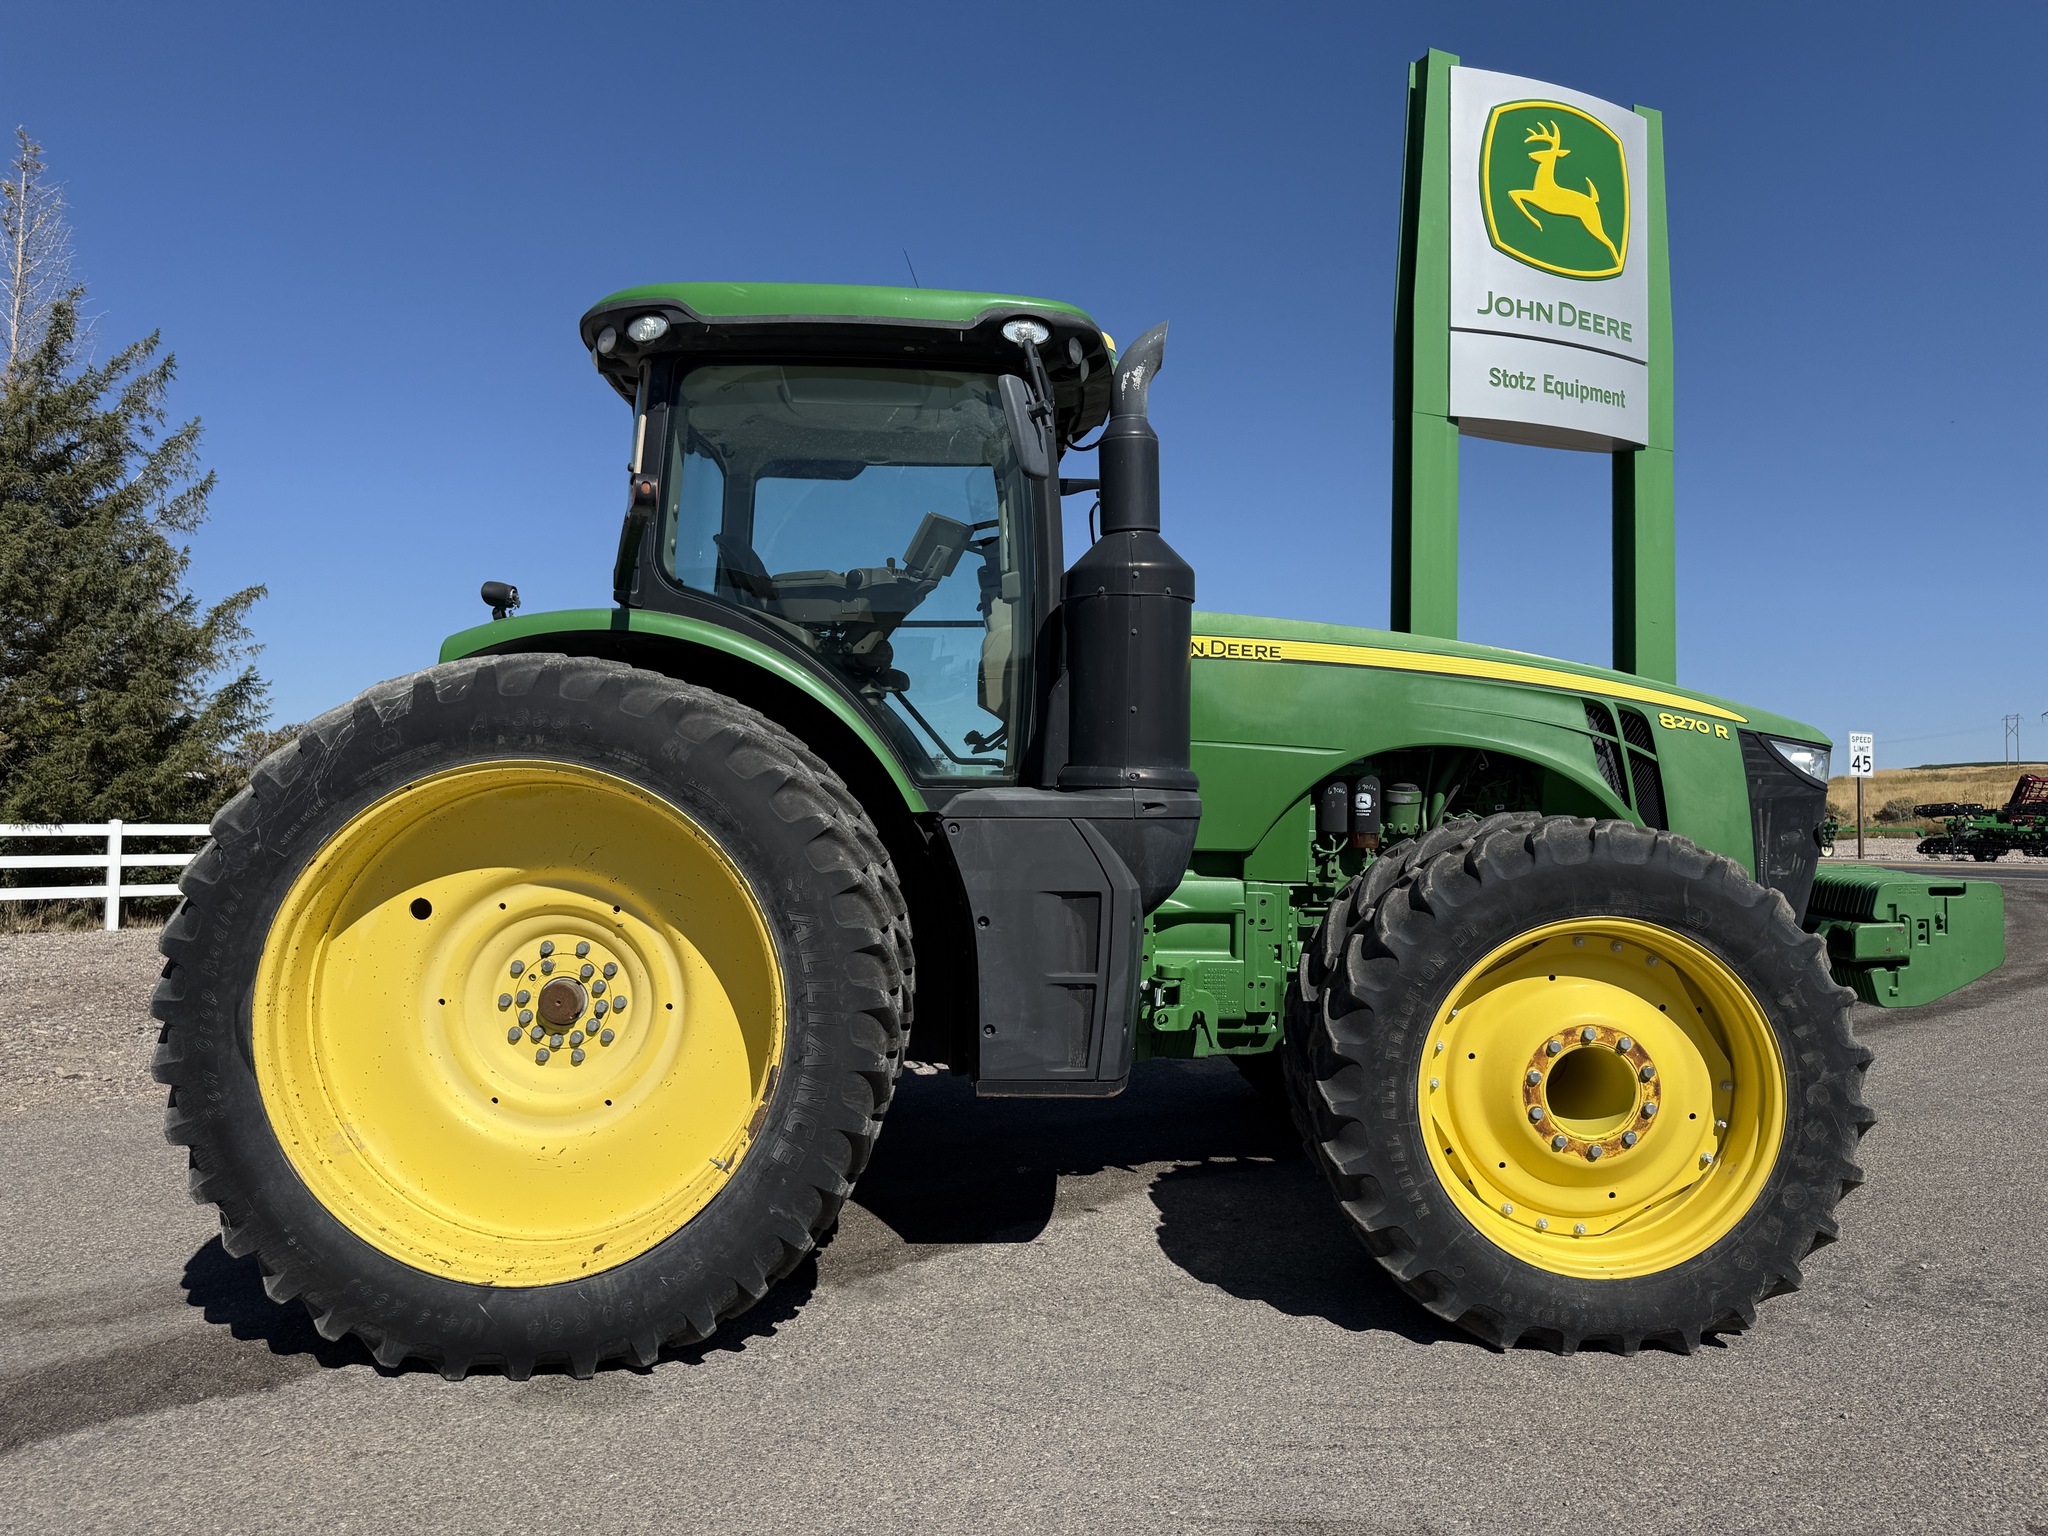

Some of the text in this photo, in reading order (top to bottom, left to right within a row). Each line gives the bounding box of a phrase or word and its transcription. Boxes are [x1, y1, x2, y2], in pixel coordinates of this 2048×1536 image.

[1477, 291, 1632, 343] JOHN DEERE
[1489, 367, 1626, 409] Stotz Equipment
[1211, 640, 1282, 659] DEERE
[1851, 735, 1872, 744] SPEED
[1853, 745, 1870, 753] LIMIT
[1851, 754, 1872, 773] 45
[1384, 952, 1447, 1062] TRACTION
[771, 910, 838, 1175] ALLIANCE
[1379, 1075, 1398, 1121] ALL
[1385, 1134, 1432, 1221] RADIAL
